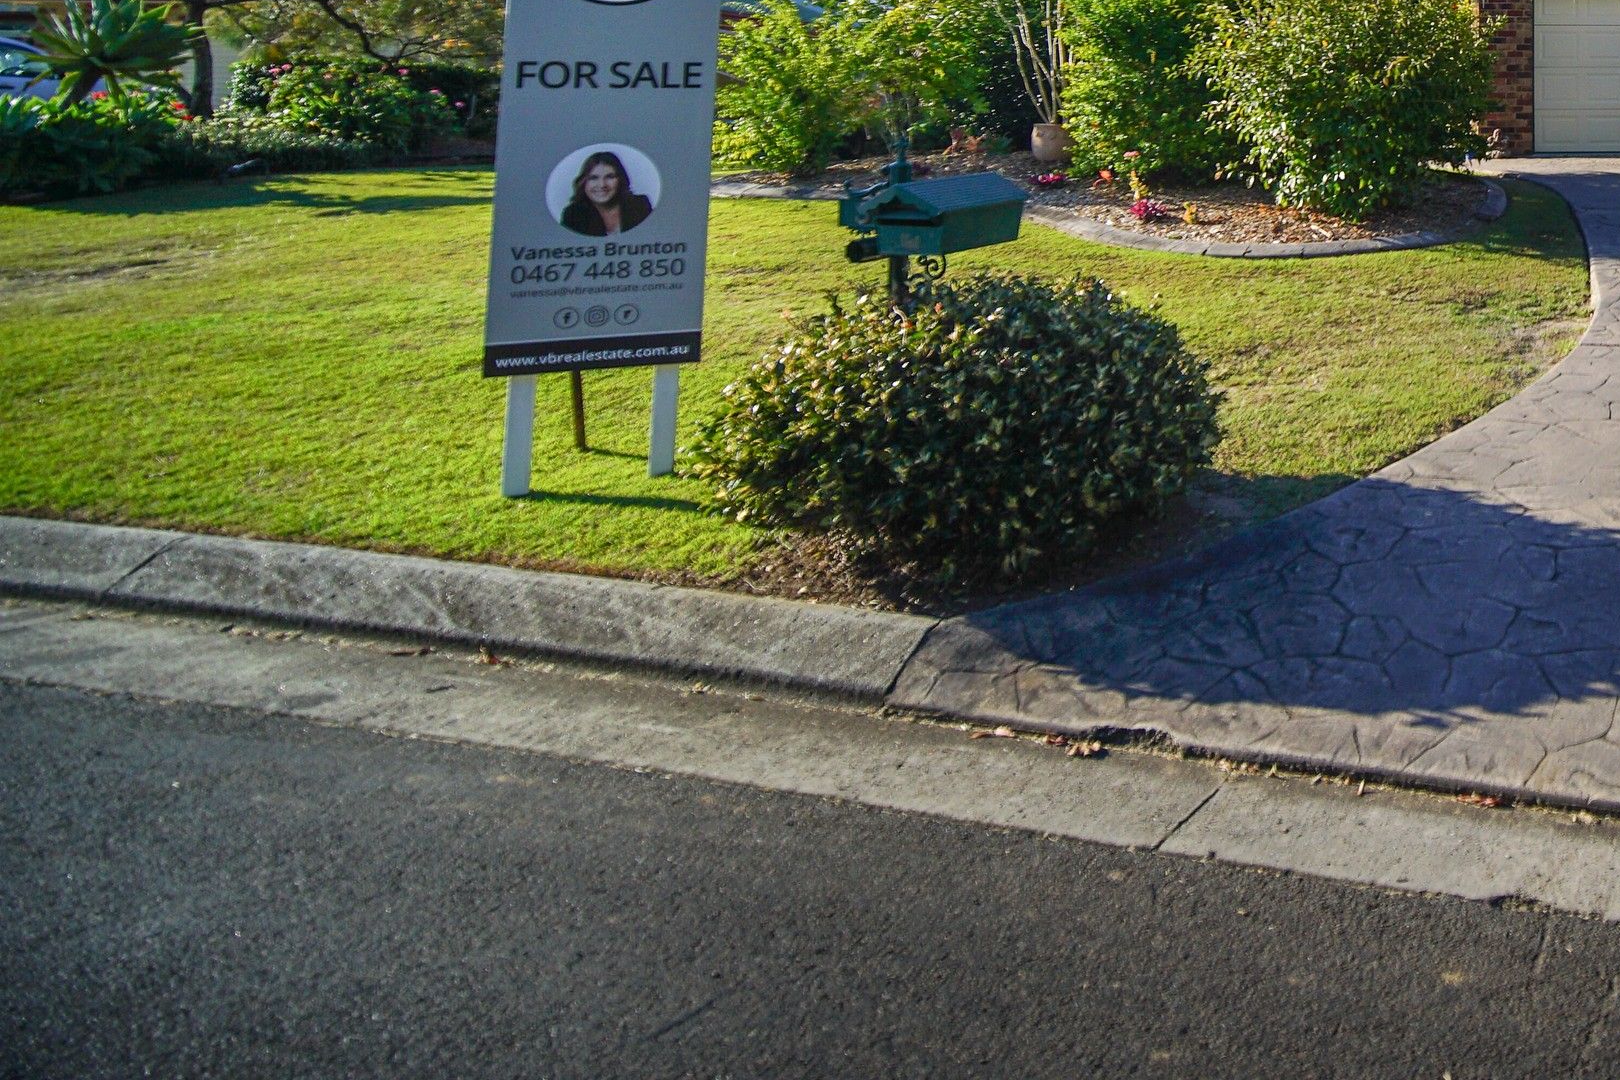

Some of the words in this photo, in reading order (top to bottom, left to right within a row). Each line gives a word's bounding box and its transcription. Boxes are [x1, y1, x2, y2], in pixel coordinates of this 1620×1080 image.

[516, 61, 598, 89] FOR
[608, 61, 703, 89] SALE
[511, 246, 597, 261] Vanessa
[604, 242, 688, 257] Brunton
[510, 263, 577, 284] 0467
[584, 260, 631, 280] 448
[639, 258, 685, 278] 850
[510, 282, 684, 299] vanessa@vbrealestate.com.au
[495, 344, 689, 367] www.vbrealestate.com.au
